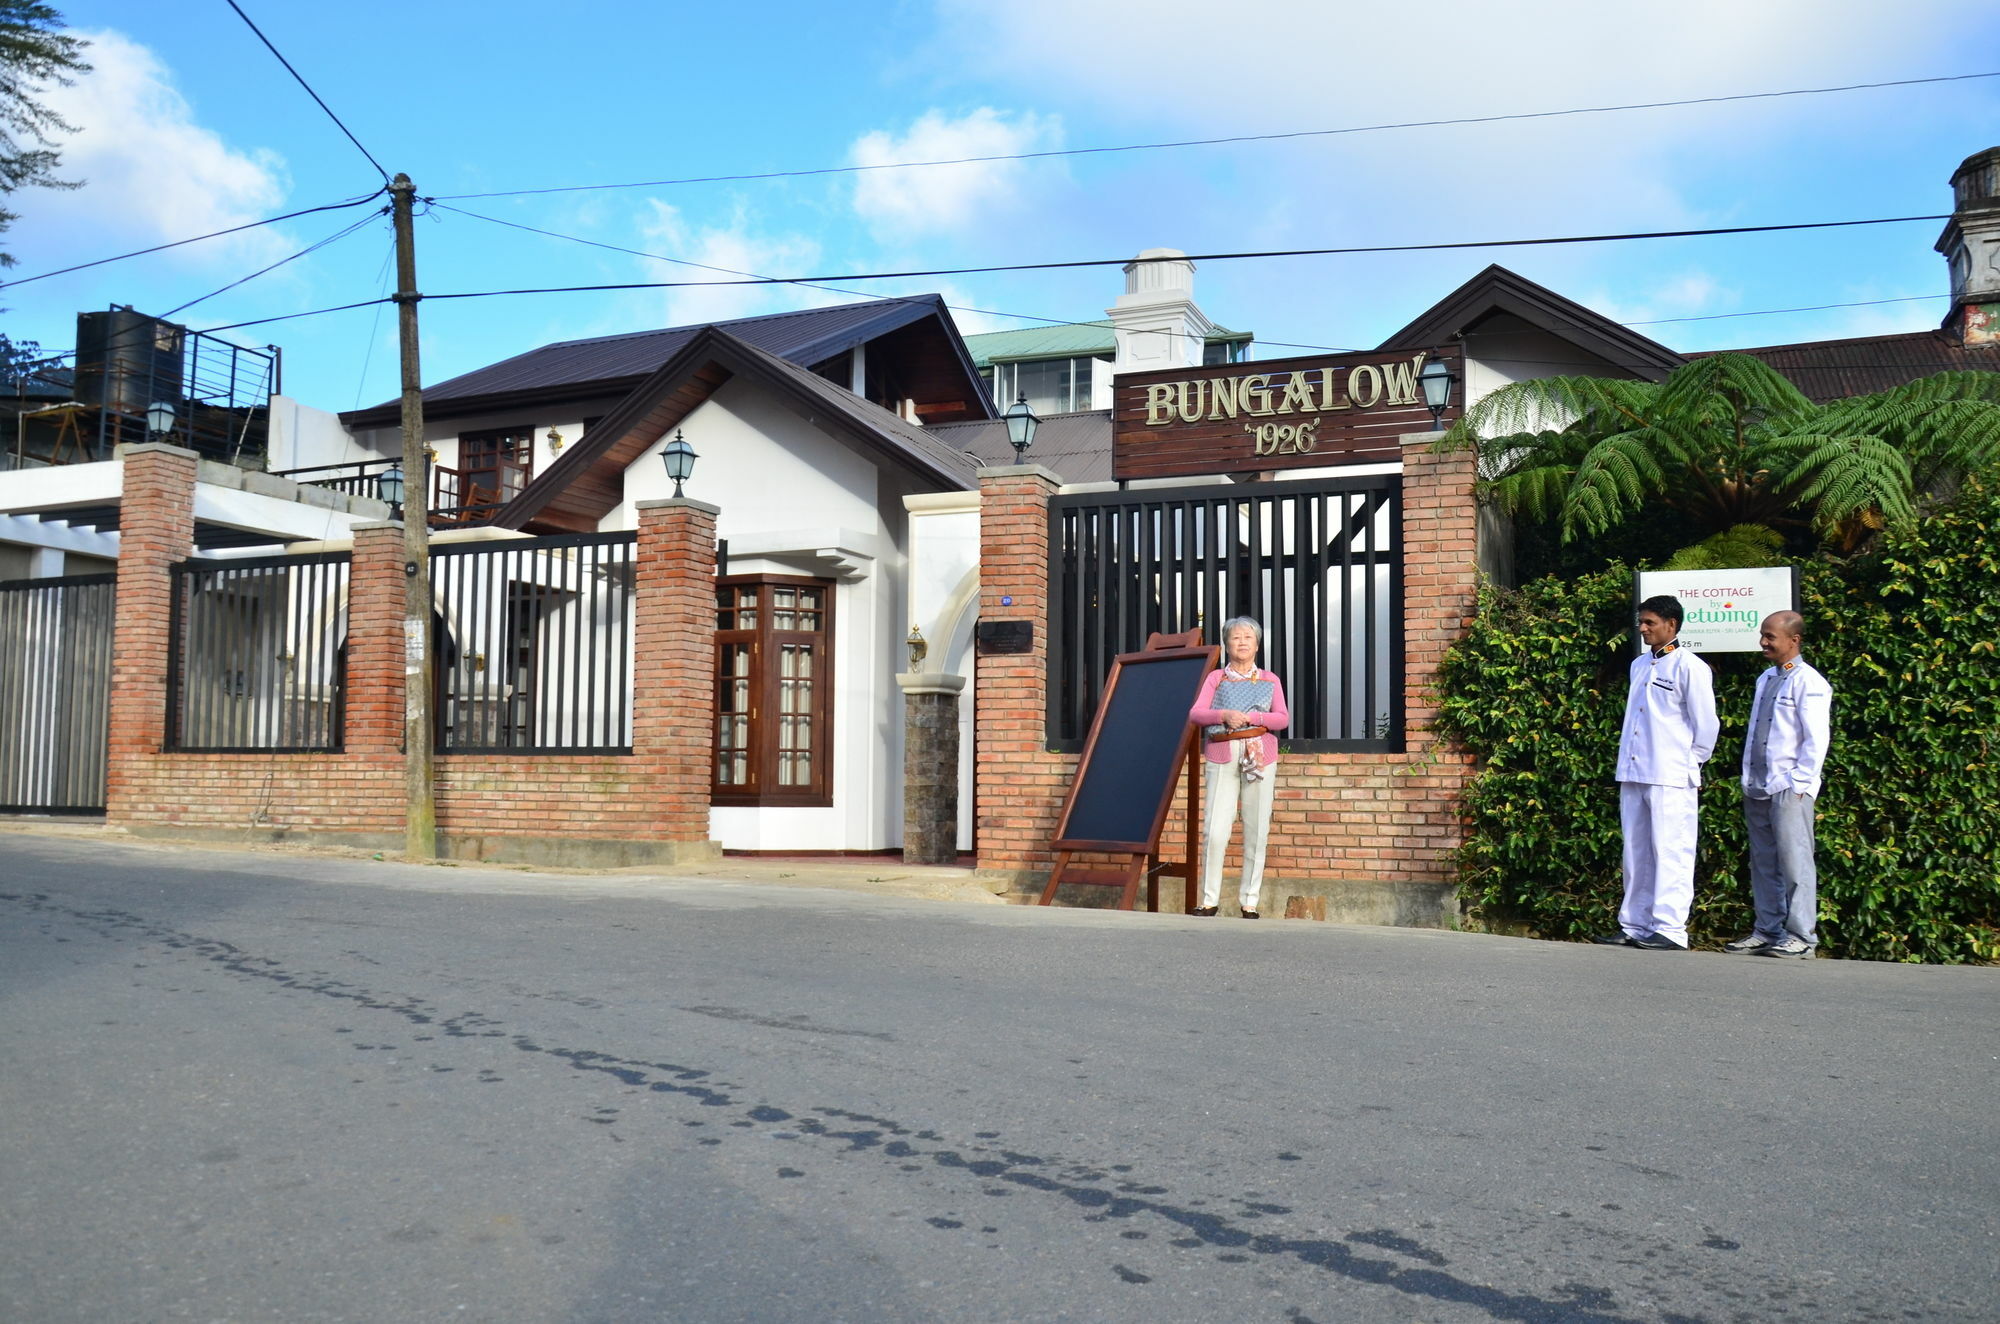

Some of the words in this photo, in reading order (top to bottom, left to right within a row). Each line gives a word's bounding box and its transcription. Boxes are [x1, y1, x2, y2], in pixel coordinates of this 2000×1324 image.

[1145, 351, 1427, 426] BUNGALOW
[1678, 589, 1699, 598] THE
[1702, 587, 1754, 598] COTTAGE
[1710, 599, 1721, 609] by
[1681, 640, 1692, 648] 25
